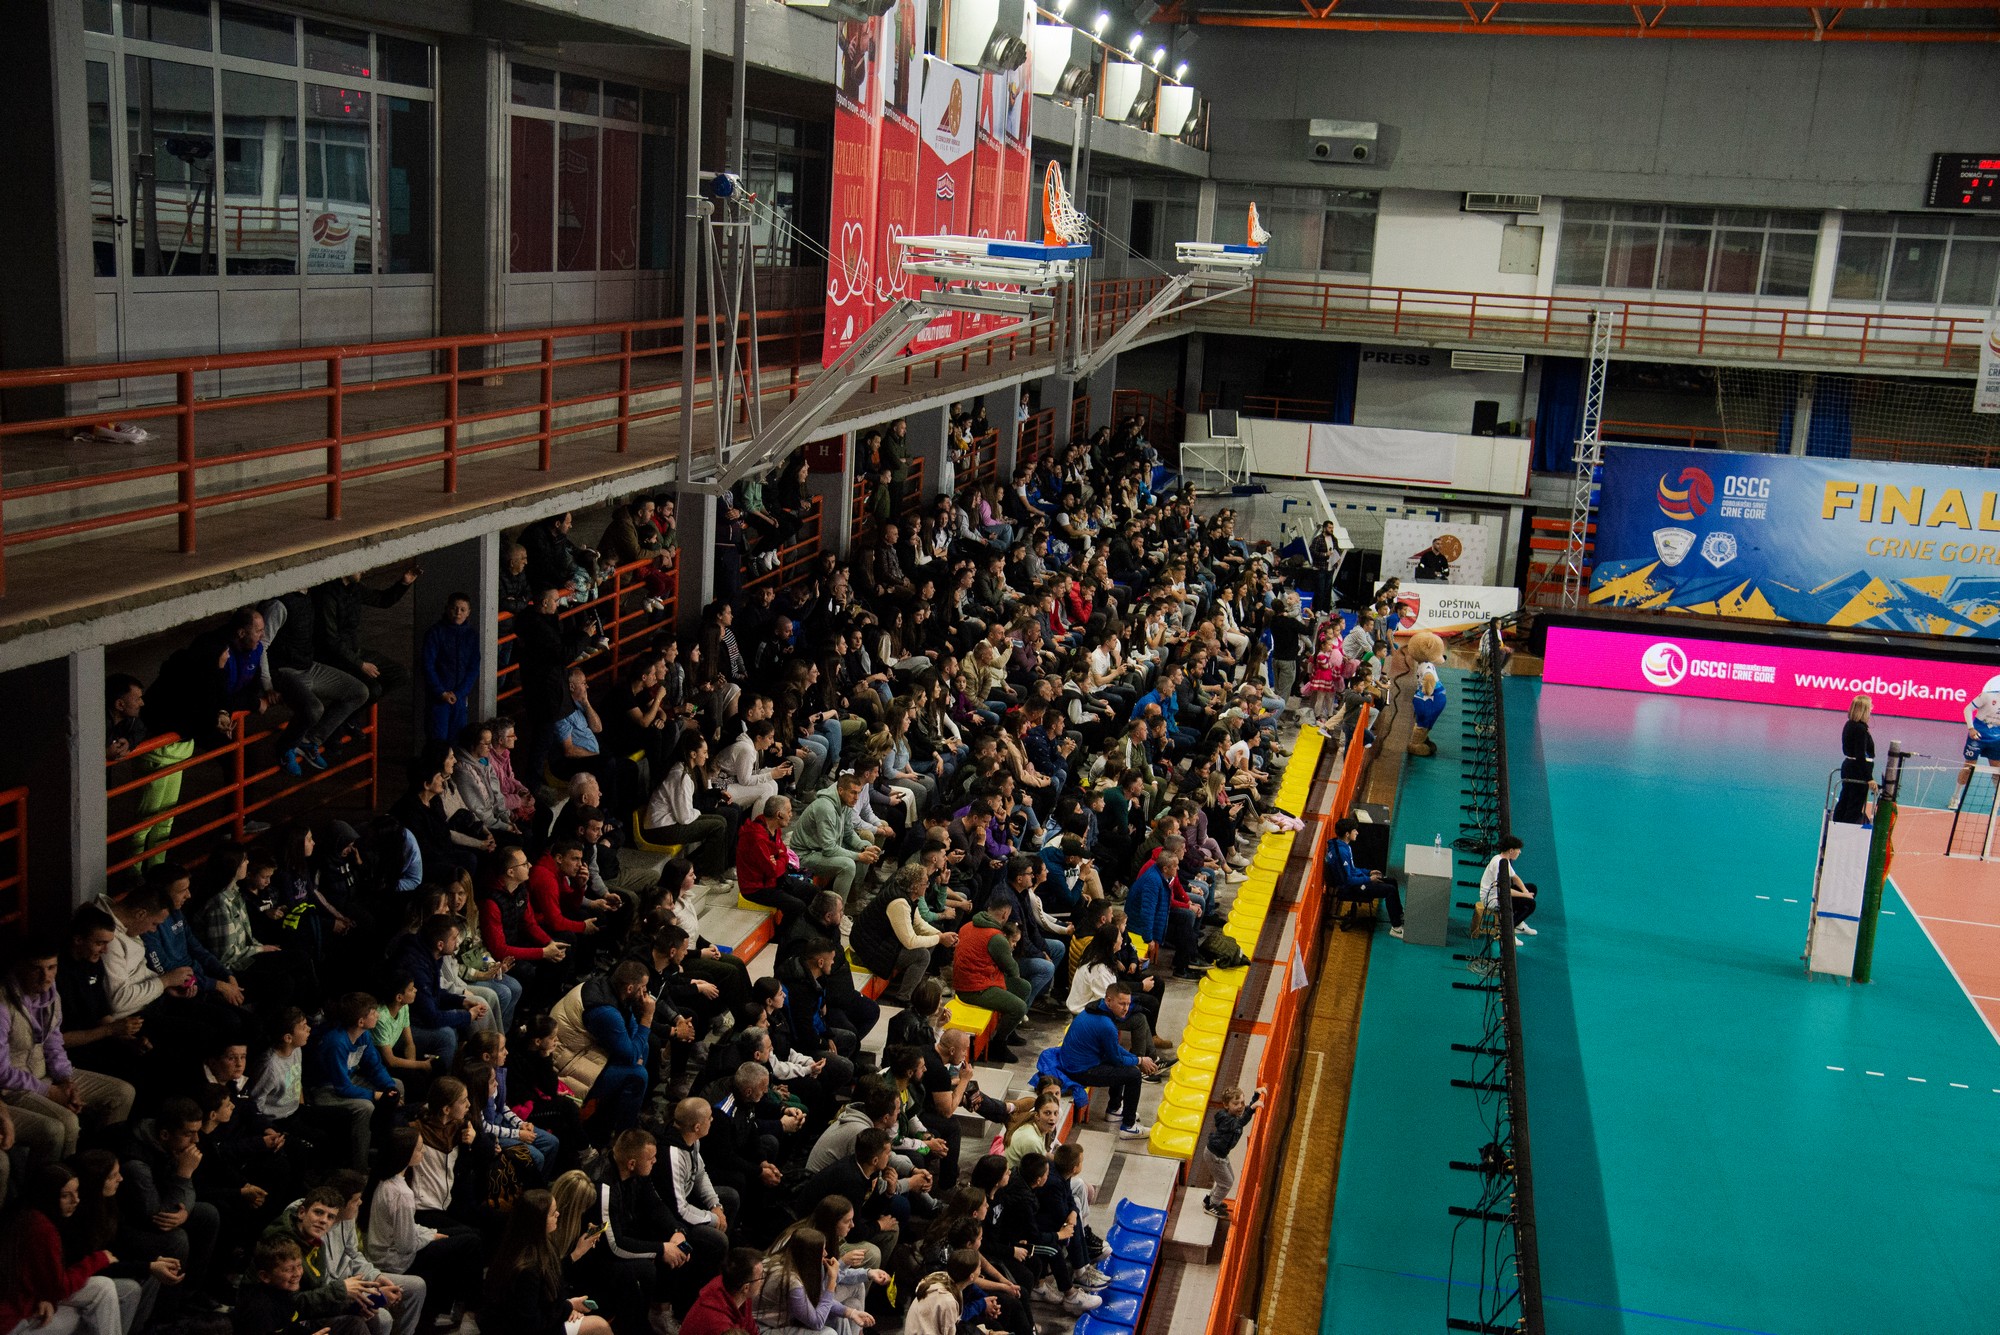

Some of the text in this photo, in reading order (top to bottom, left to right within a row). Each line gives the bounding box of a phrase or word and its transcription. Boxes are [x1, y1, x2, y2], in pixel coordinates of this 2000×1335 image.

[859, 326, 893, 359] MUSCULUS
[1362, 351, 1431, 366] PRESS
[819, 445, 829, 456] H
[1723, 475, 1771, 498] OSCG
[1720, 506, 1767, 520] CRNE GORE
[1821, 480, 2000, 531] FINAL
[1865, 536, 1937, 561] CRNE
[1438, 599, 1481, 609] OPŠTINA
[1428, 610, 1491, 620] BIJELO POLJE
[1690, 659, 1727, 679] OSCG
[1732, 669, 1775, 683] CRNE GORE
[1794, 673, 1967, 702] www.odbojka.me
